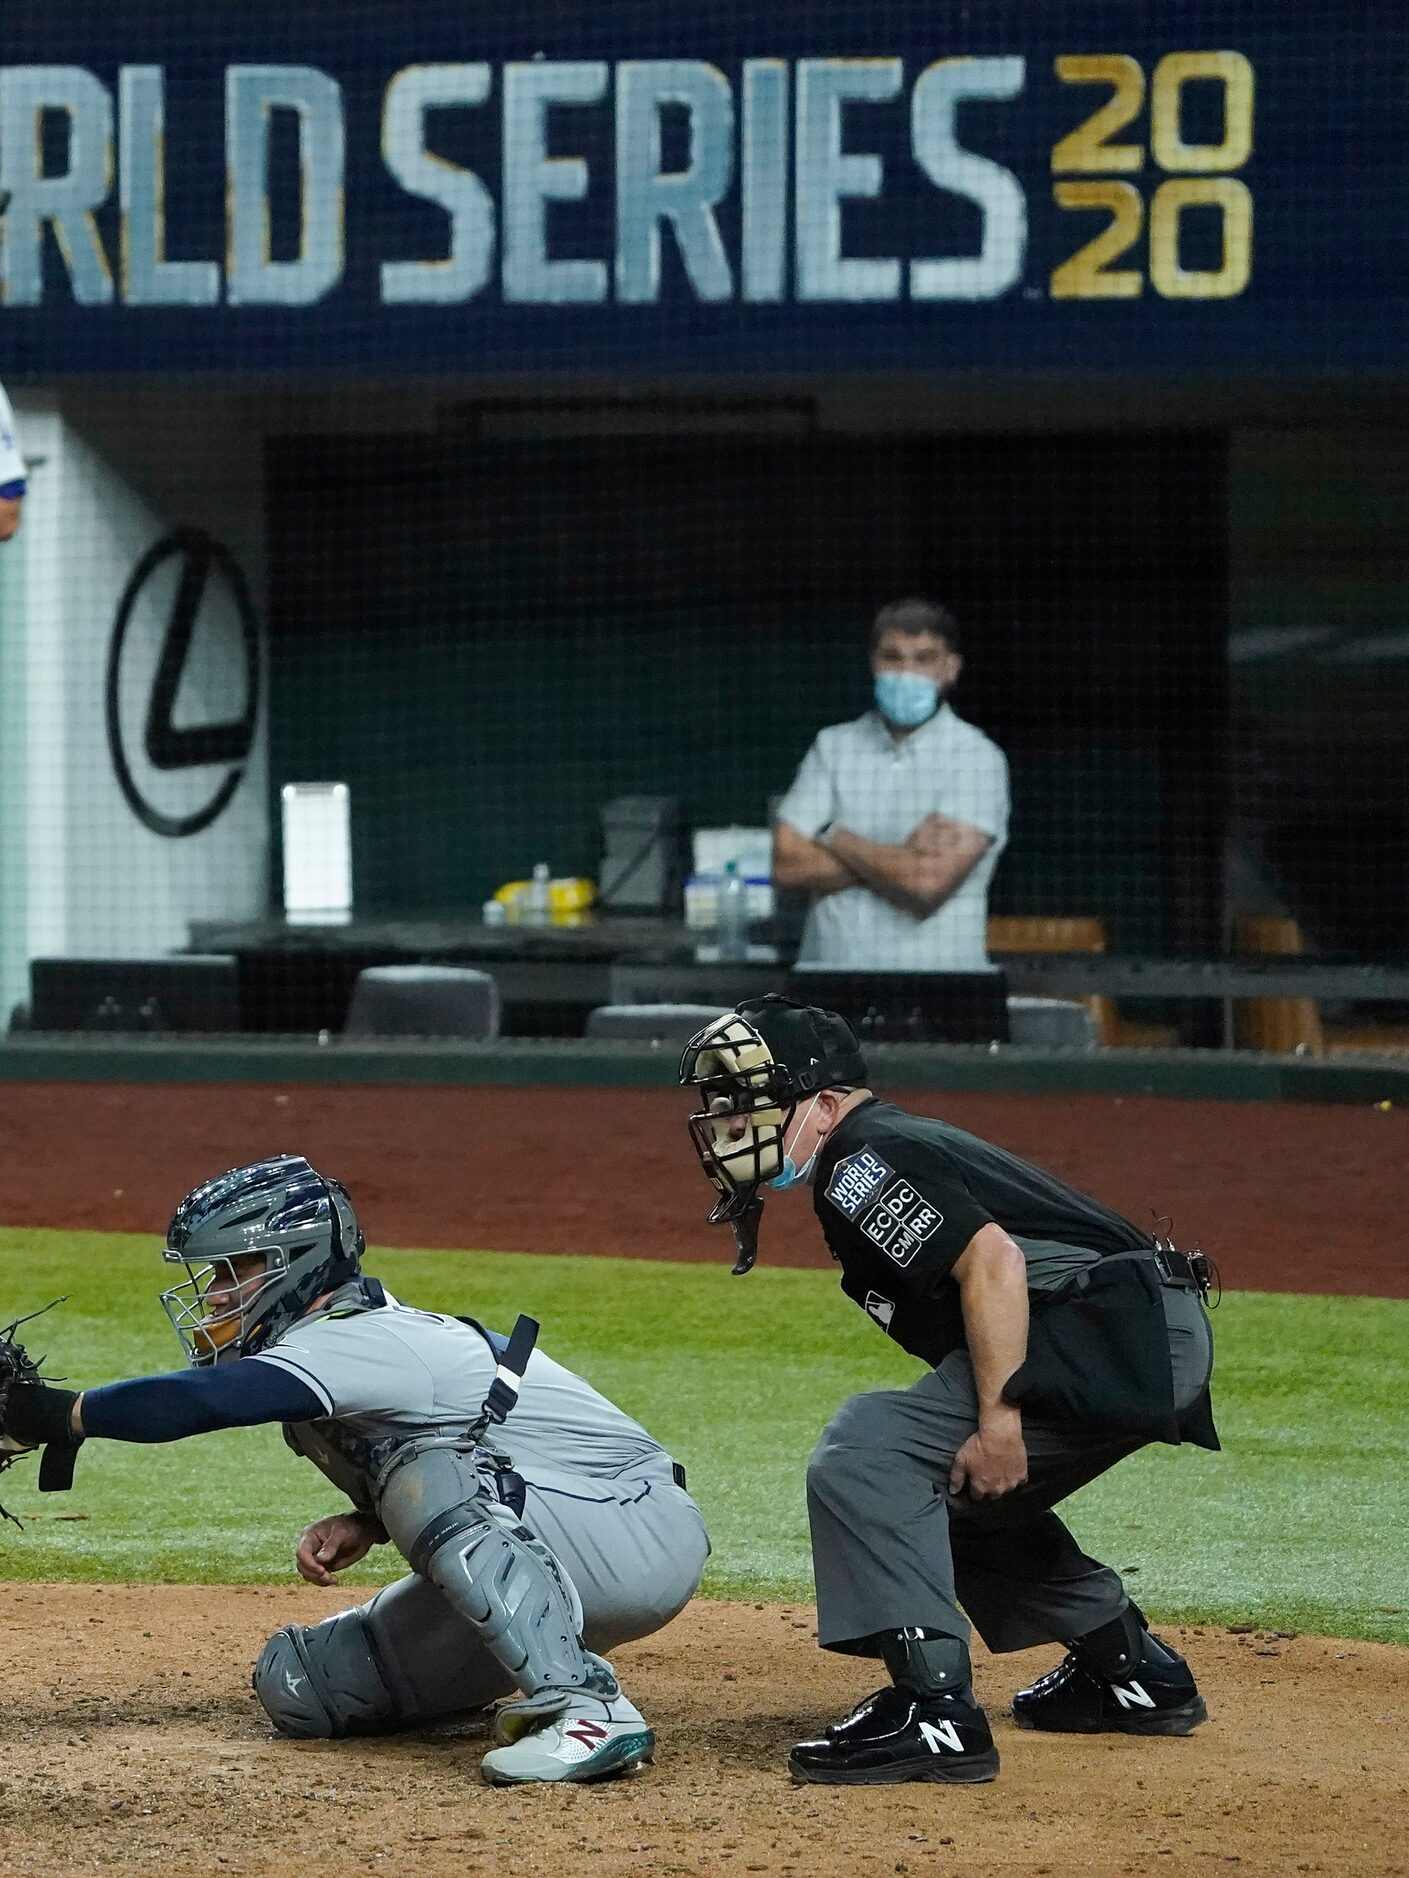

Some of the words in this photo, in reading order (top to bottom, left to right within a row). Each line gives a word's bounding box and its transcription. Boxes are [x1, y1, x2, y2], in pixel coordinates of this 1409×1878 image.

[1051, 50, 1255, 172] 20
[380, 54, 1029, 303] SERIES
[1050, 177, 1253, 299] 20
[831, 1153, 875, 1202] WORLD
[841, 1162, 887, 1214] SERIES
[867, 1212, 892, 1241] EC
[887, 1188, 914, 1215] DC
[891, 1231, 915, 1259] CM
[909, 1208, 937, 1235] RR
